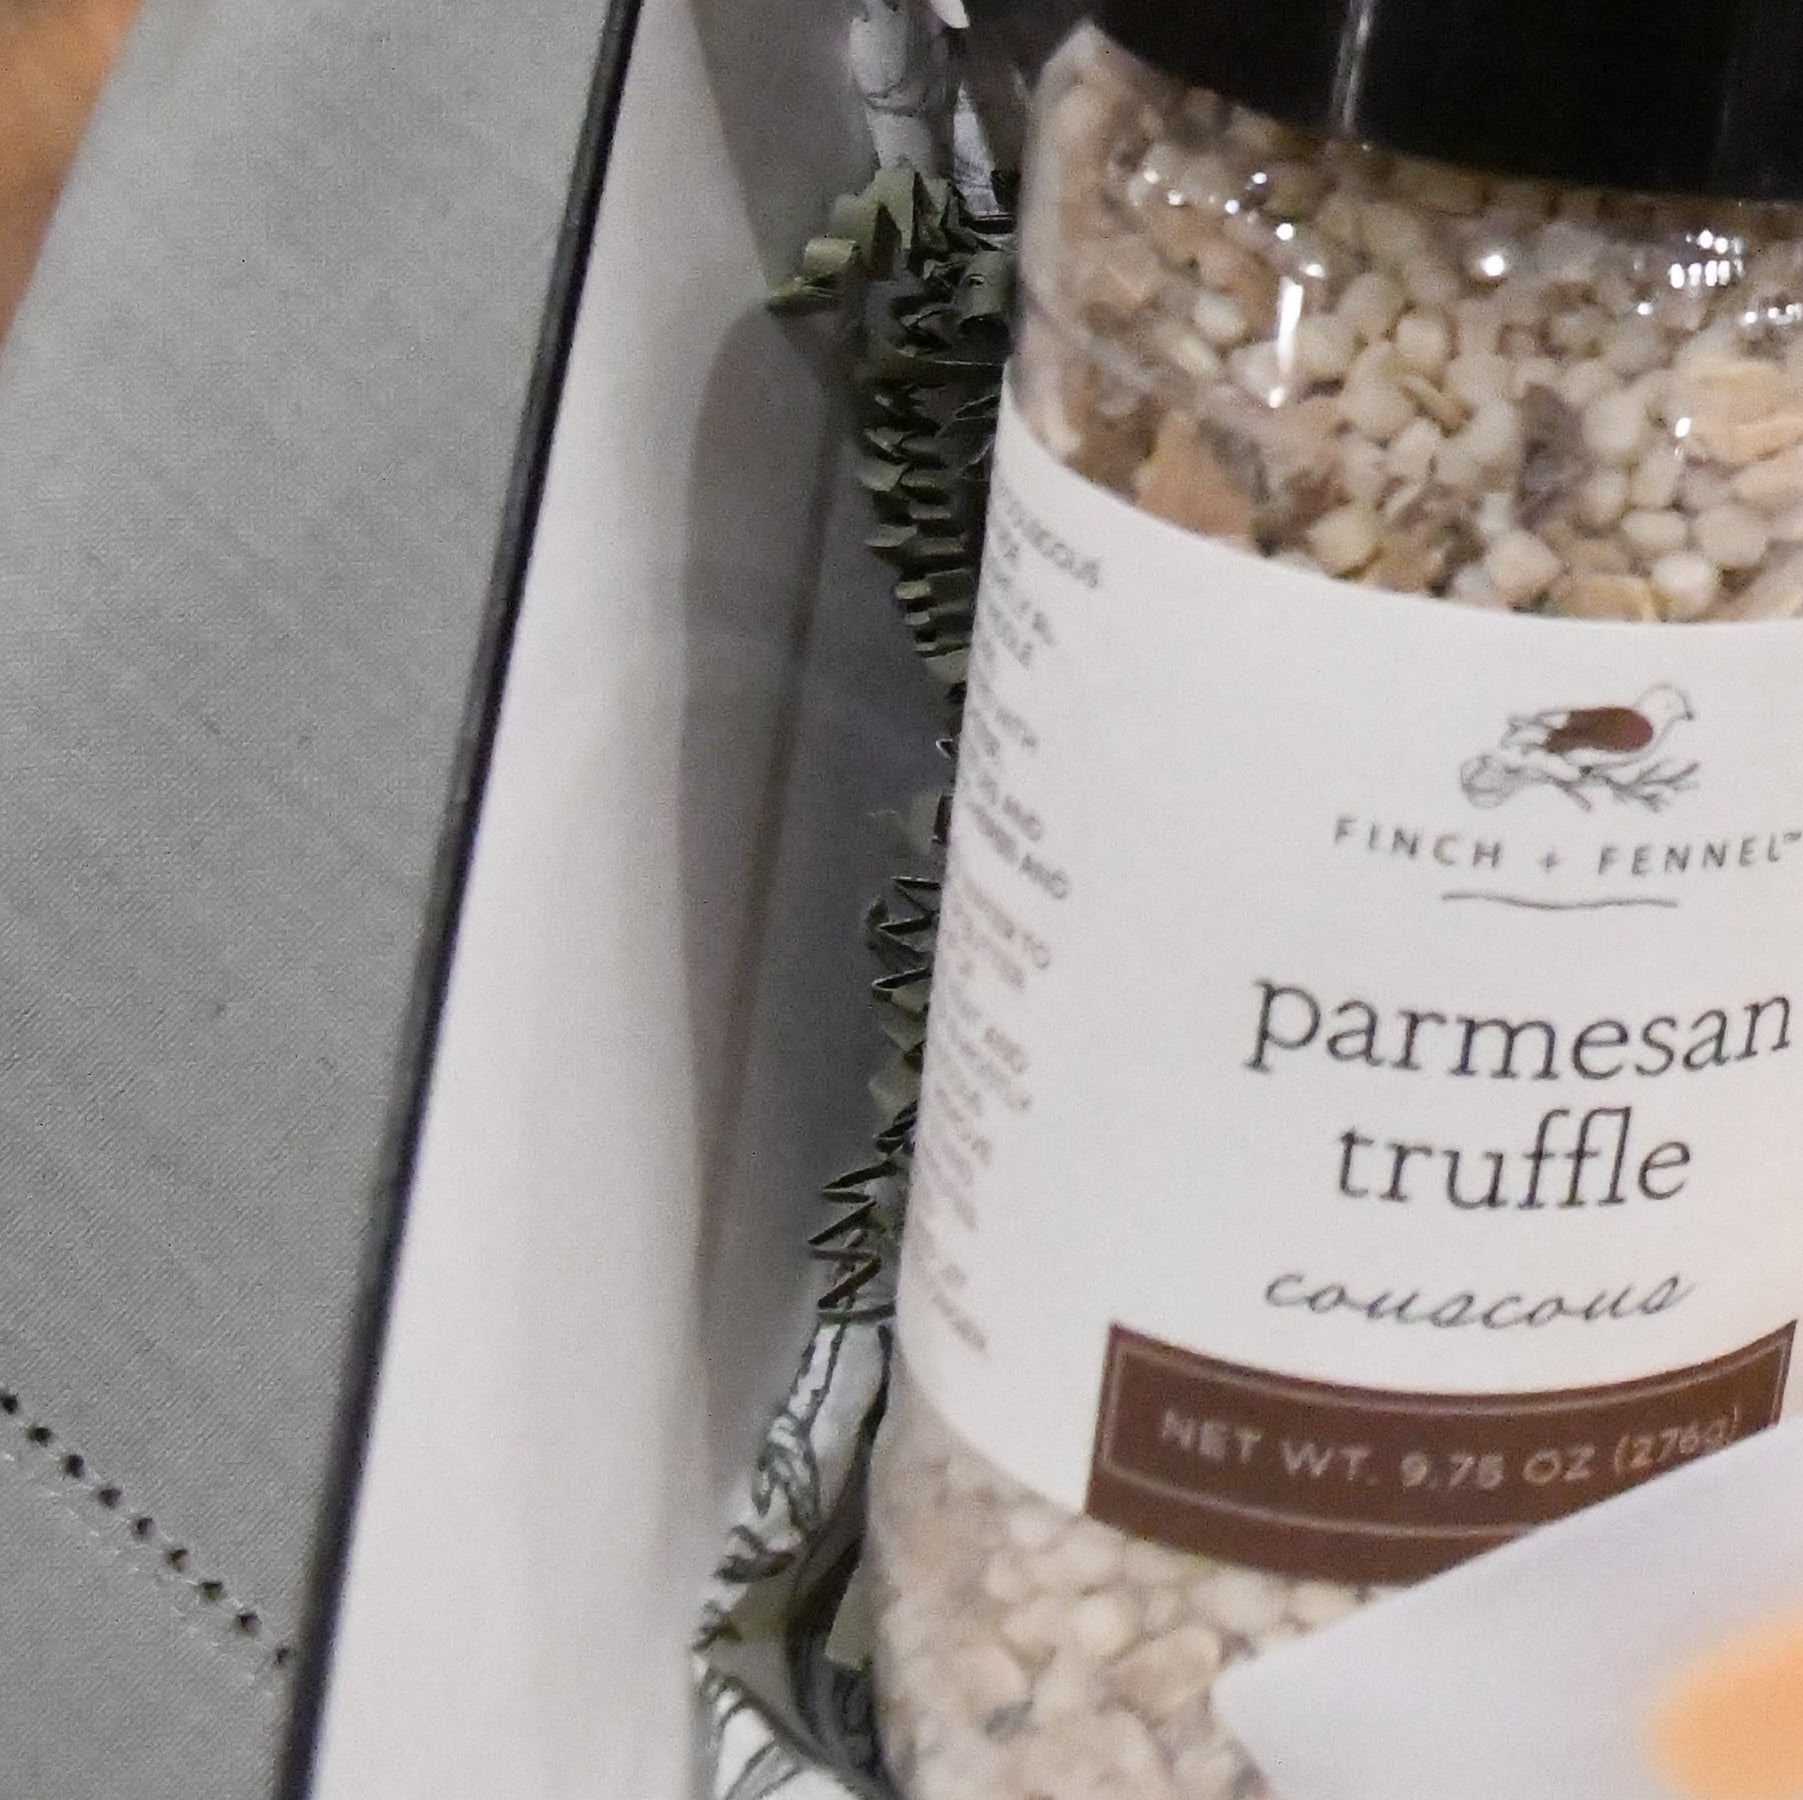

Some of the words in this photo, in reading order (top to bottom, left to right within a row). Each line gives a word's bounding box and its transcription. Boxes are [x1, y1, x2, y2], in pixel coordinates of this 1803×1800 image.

[1333, 814, 1501, 870] FINCH
[1538, 851, 1561, 872] +
[1243, 977, 1795, 1083] parmesan
[1336, 1104, 1692, 1212] truffle
[1263, 1270, 1698, 1333] couscous
[1161, 1408, 1262, 1464] NET
[1401, 1451, 1502, 1491] 9.75
[1521, 1444, 1596, 1486] OZ
